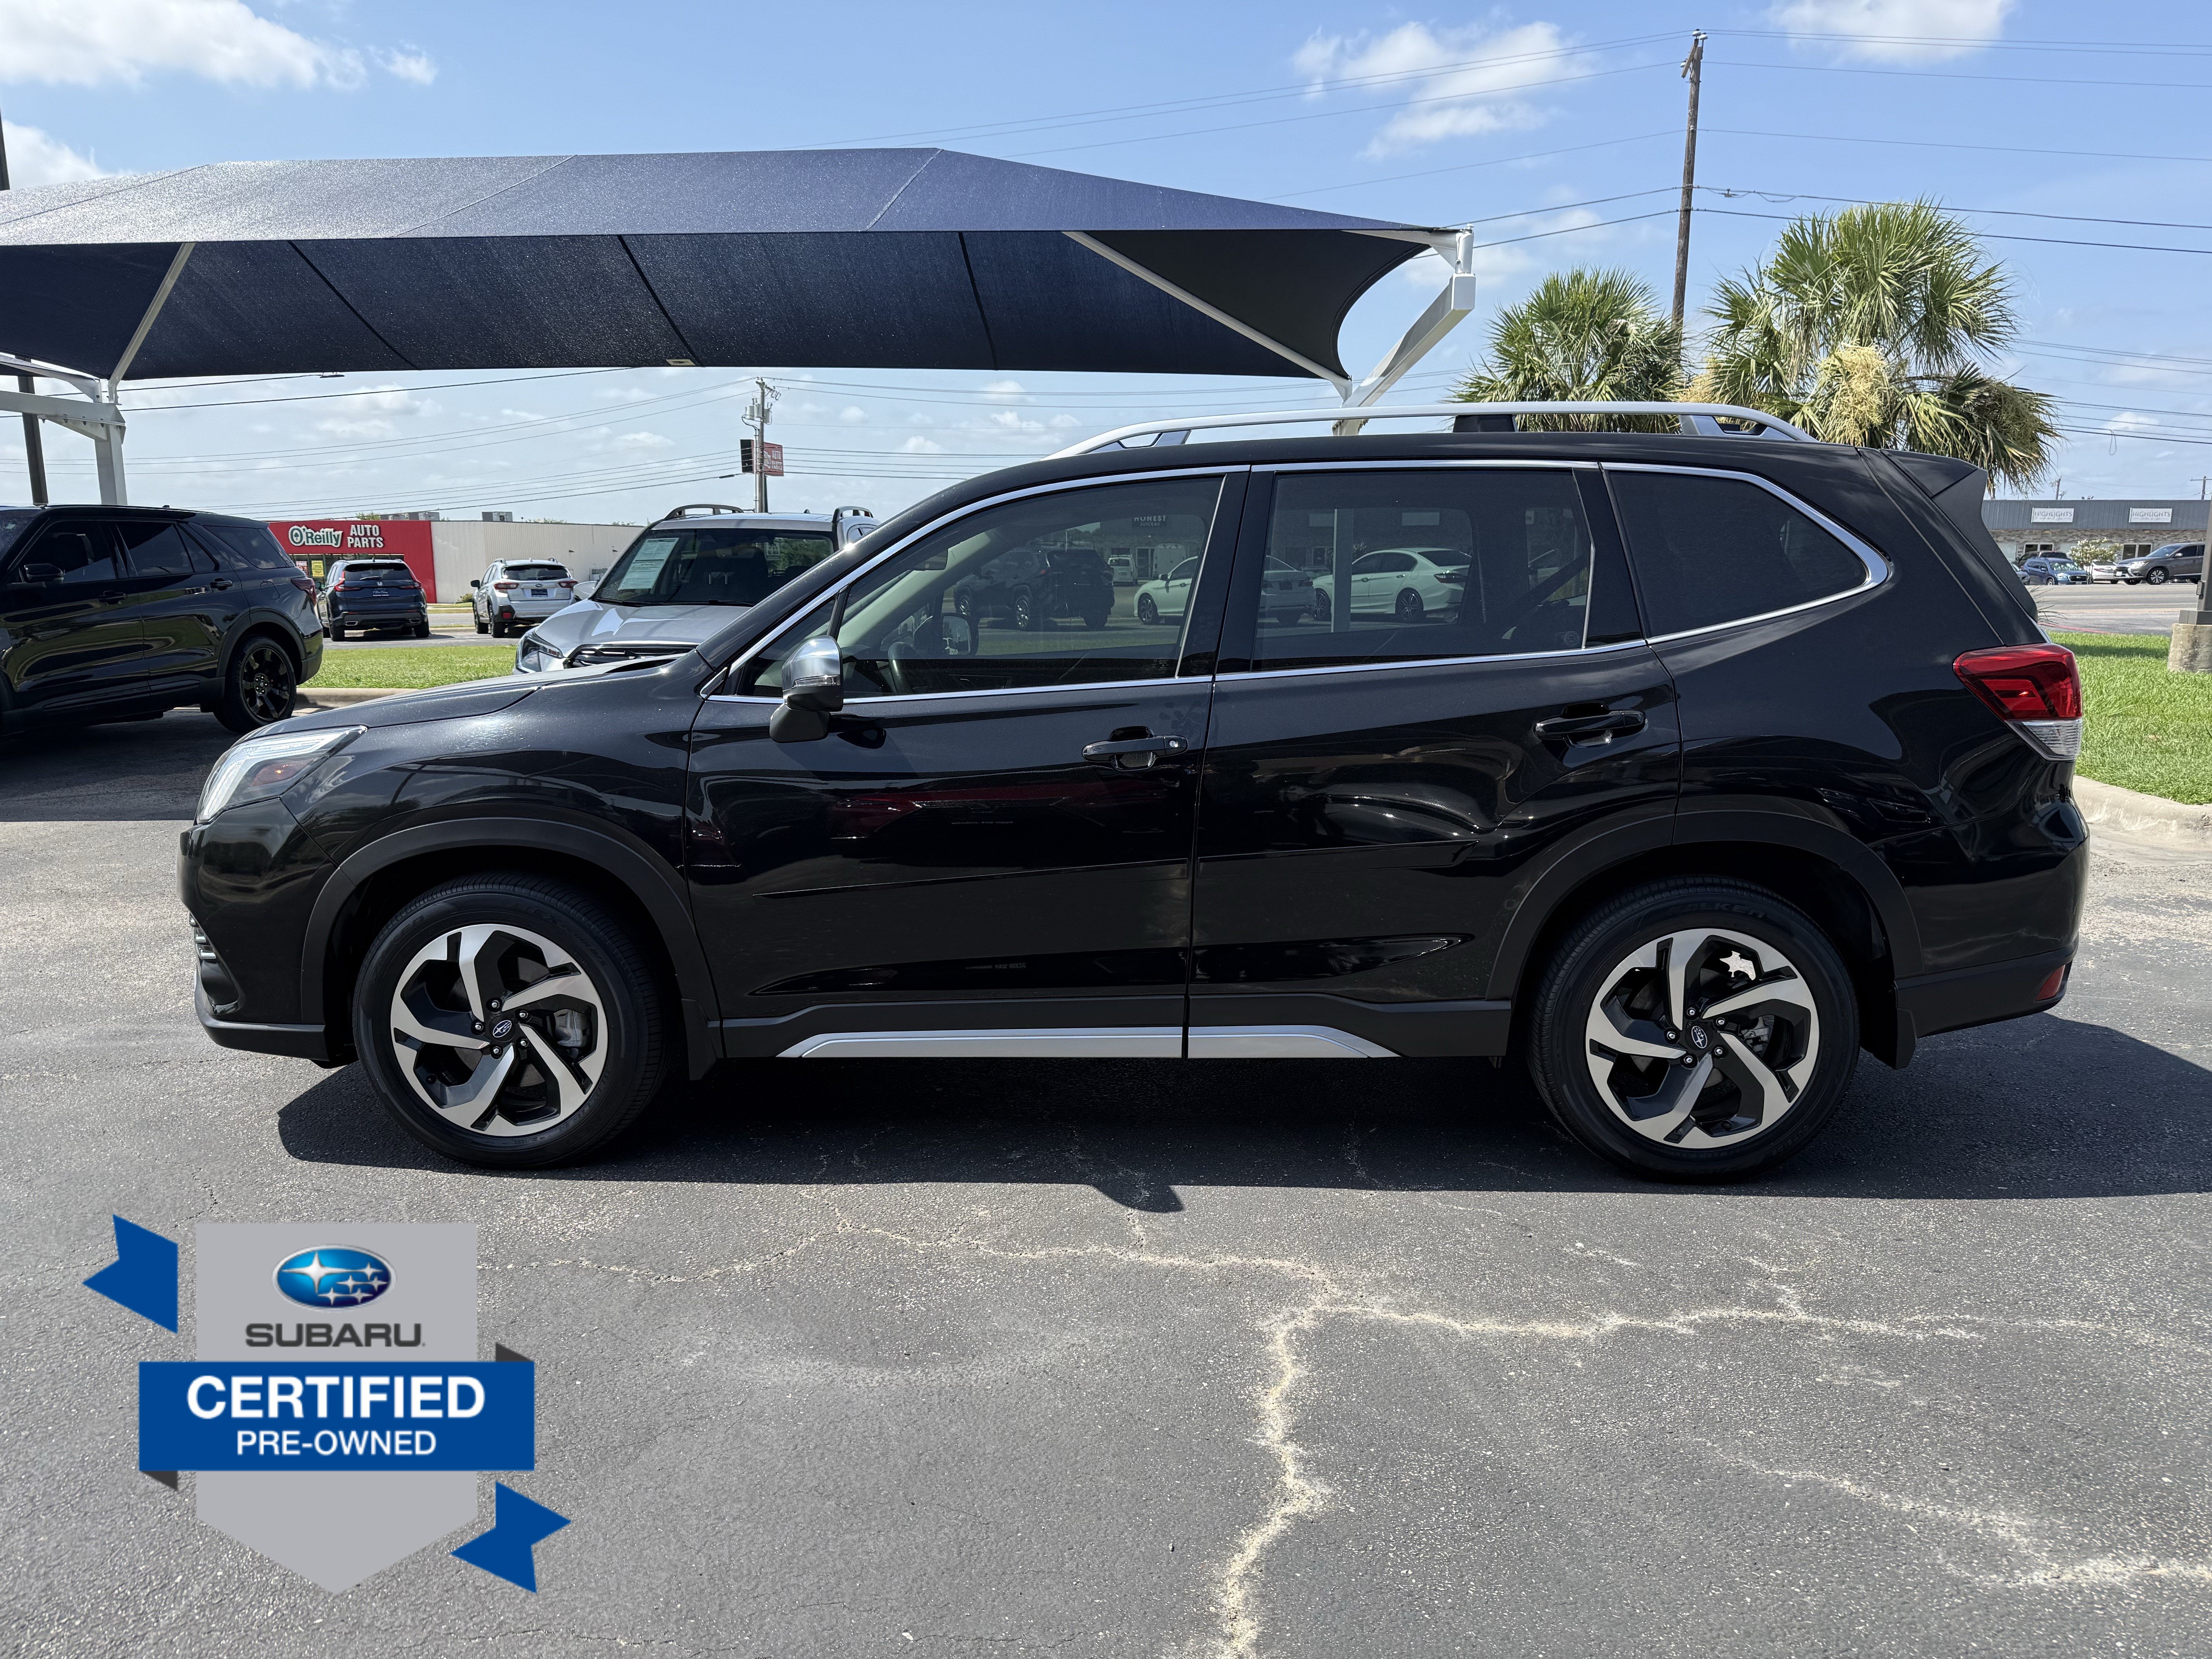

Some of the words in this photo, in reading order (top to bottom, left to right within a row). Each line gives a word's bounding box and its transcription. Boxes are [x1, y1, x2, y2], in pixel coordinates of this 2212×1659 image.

[350, 525, 379, 536] AUTO
[289, 526, 342, 547] O'Reilly
[347, 537, 384, 548] PARTS
